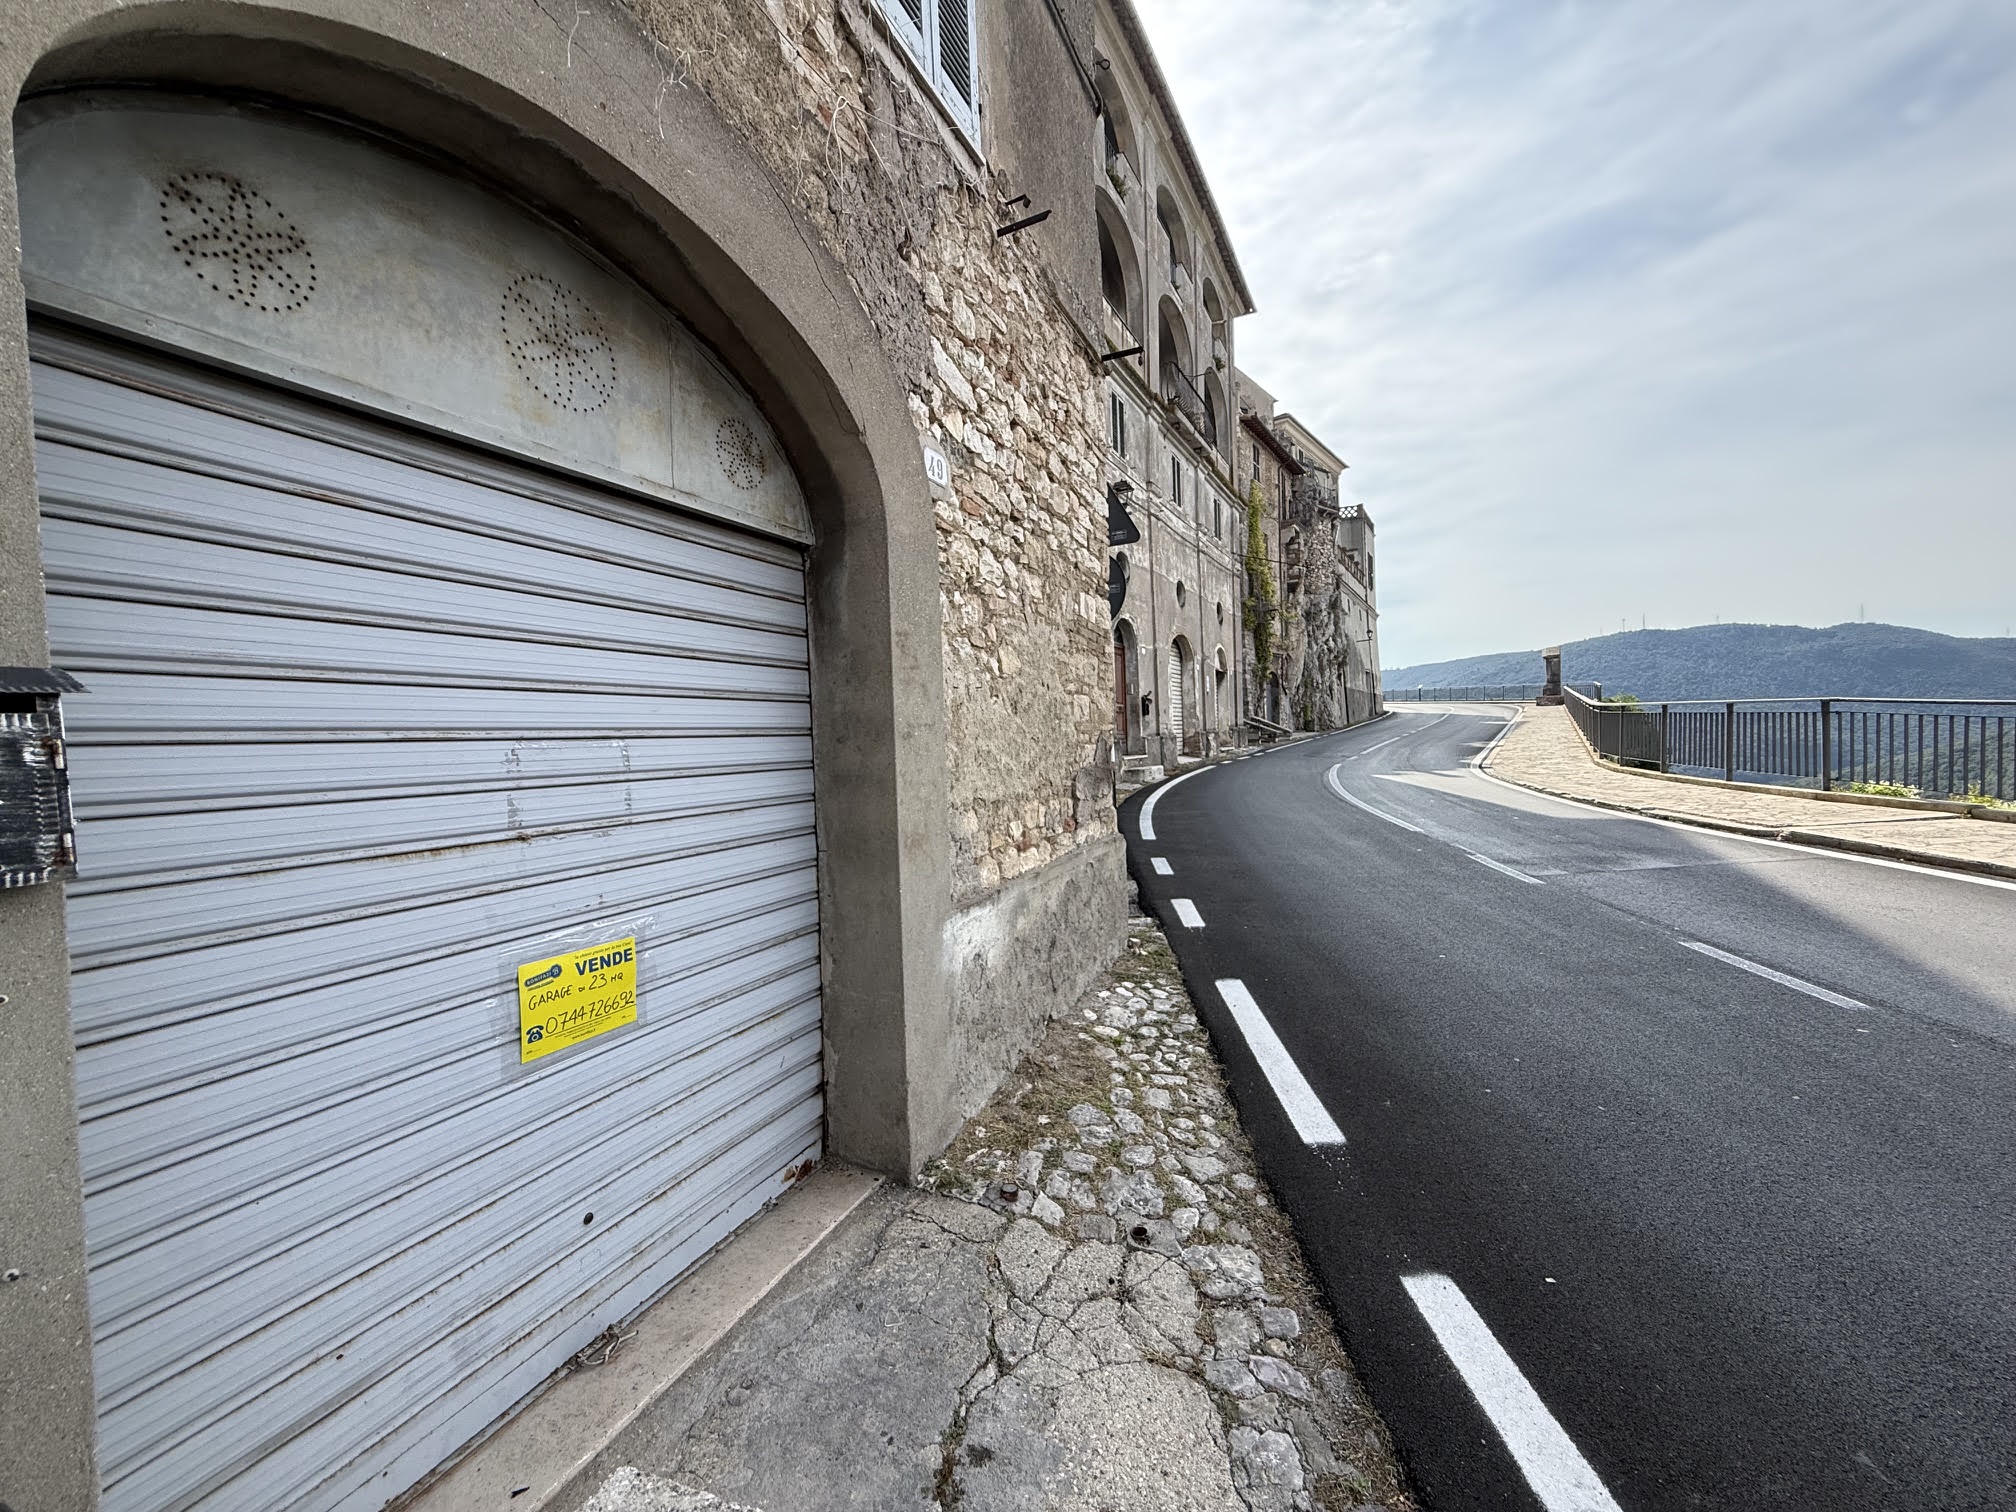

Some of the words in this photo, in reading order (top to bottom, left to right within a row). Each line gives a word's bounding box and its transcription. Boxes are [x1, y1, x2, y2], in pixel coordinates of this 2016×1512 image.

[929, 455, 943, 480] 49
[575, 947, 633, 976] VENDE
[529, 985, 573, 1011] GARAGE
[589, 973, 607, 991] 23
[545, 990, 635, 1035] 0744726692
